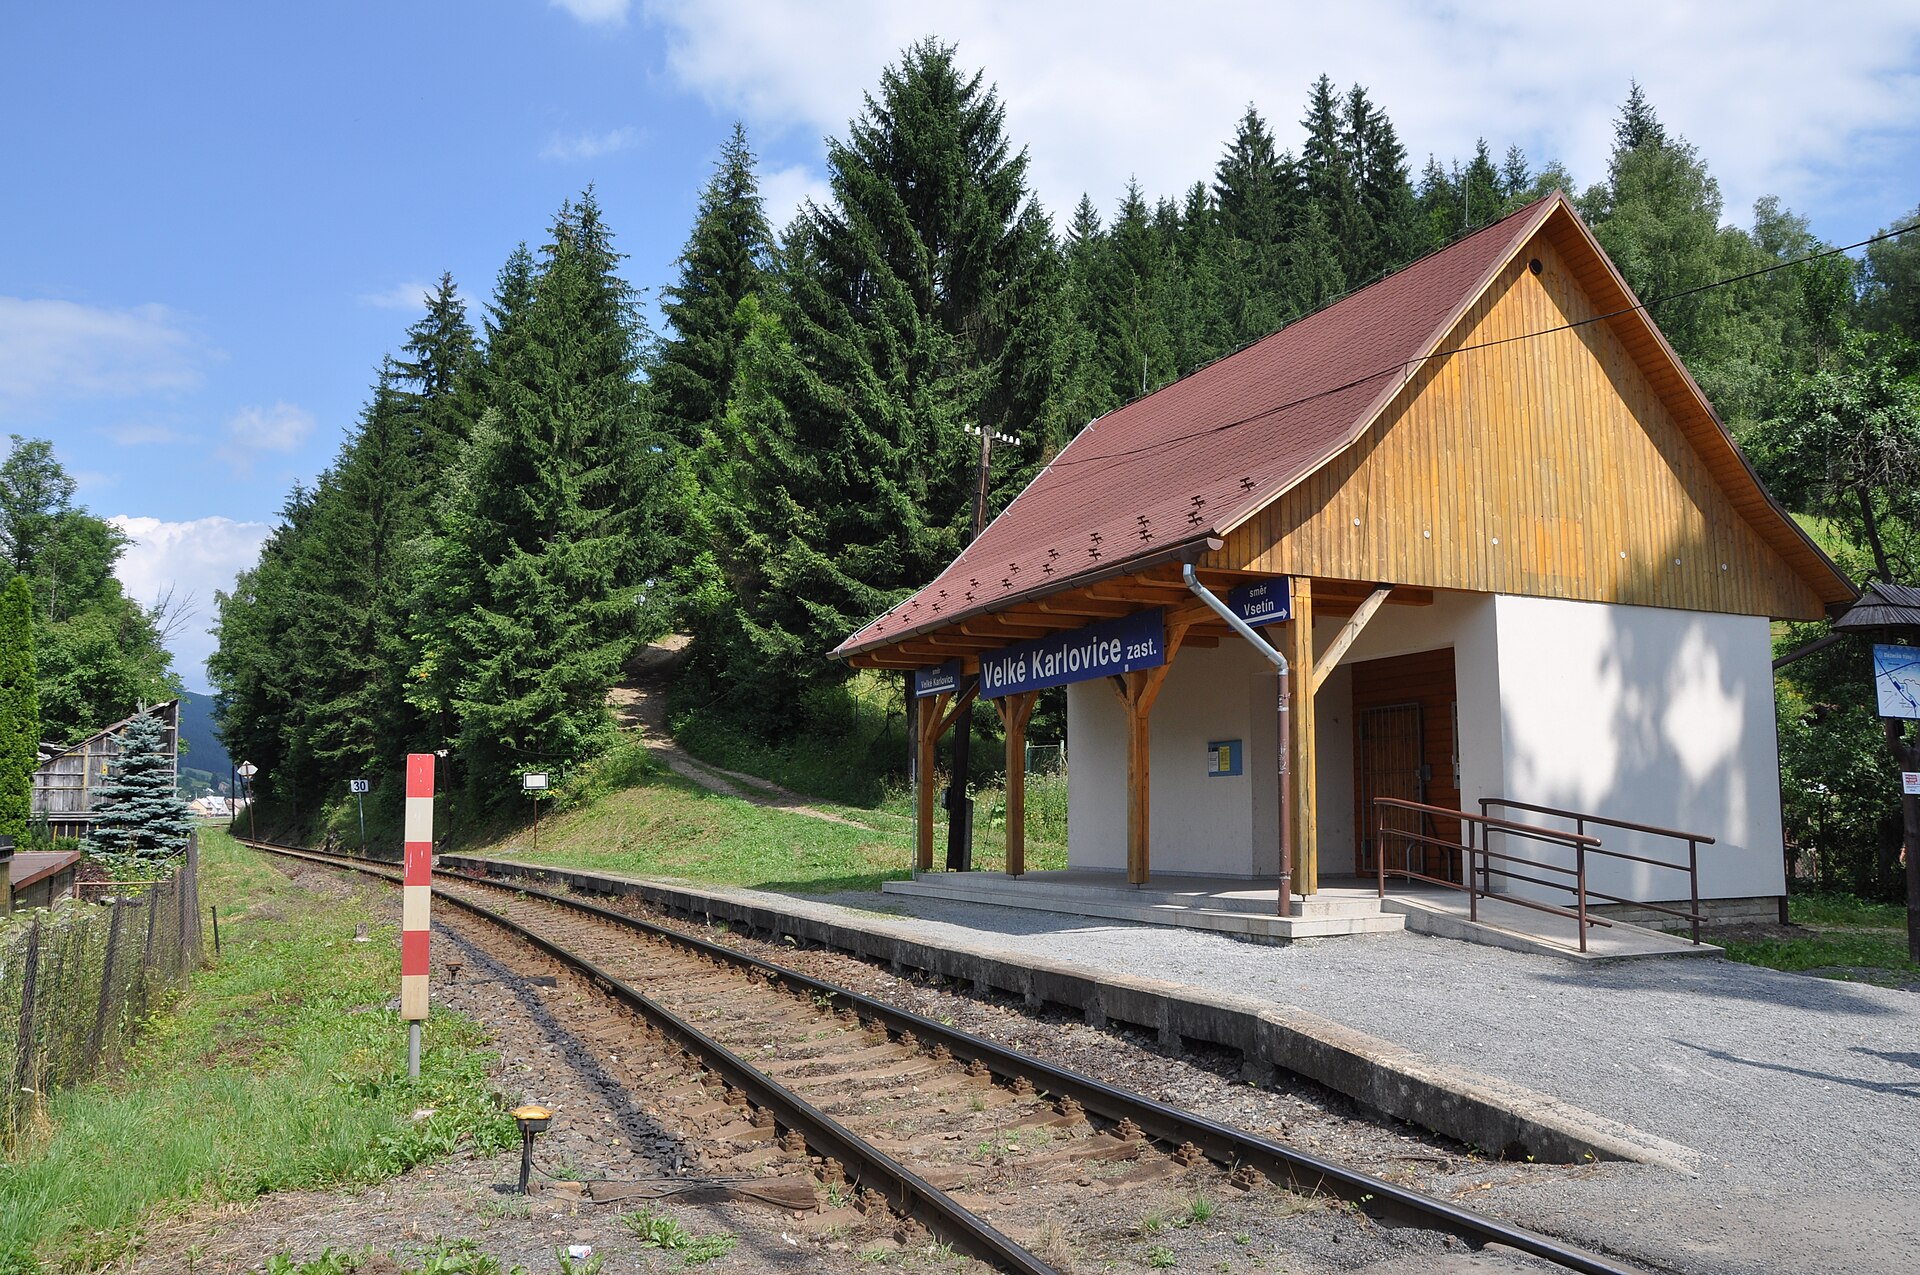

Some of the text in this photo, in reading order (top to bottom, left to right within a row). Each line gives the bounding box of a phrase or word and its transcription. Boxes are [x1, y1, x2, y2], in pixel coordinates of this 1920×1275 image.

[1249, 585, 1267, 598] směr
[1243, 598, 1274, 616] Vsetín
[983, 636, 1157, 689] Velké Karlovice zast.
[921, 675, 953, 689] Velké Karlovice
[353, 781, 366, 791] 30
